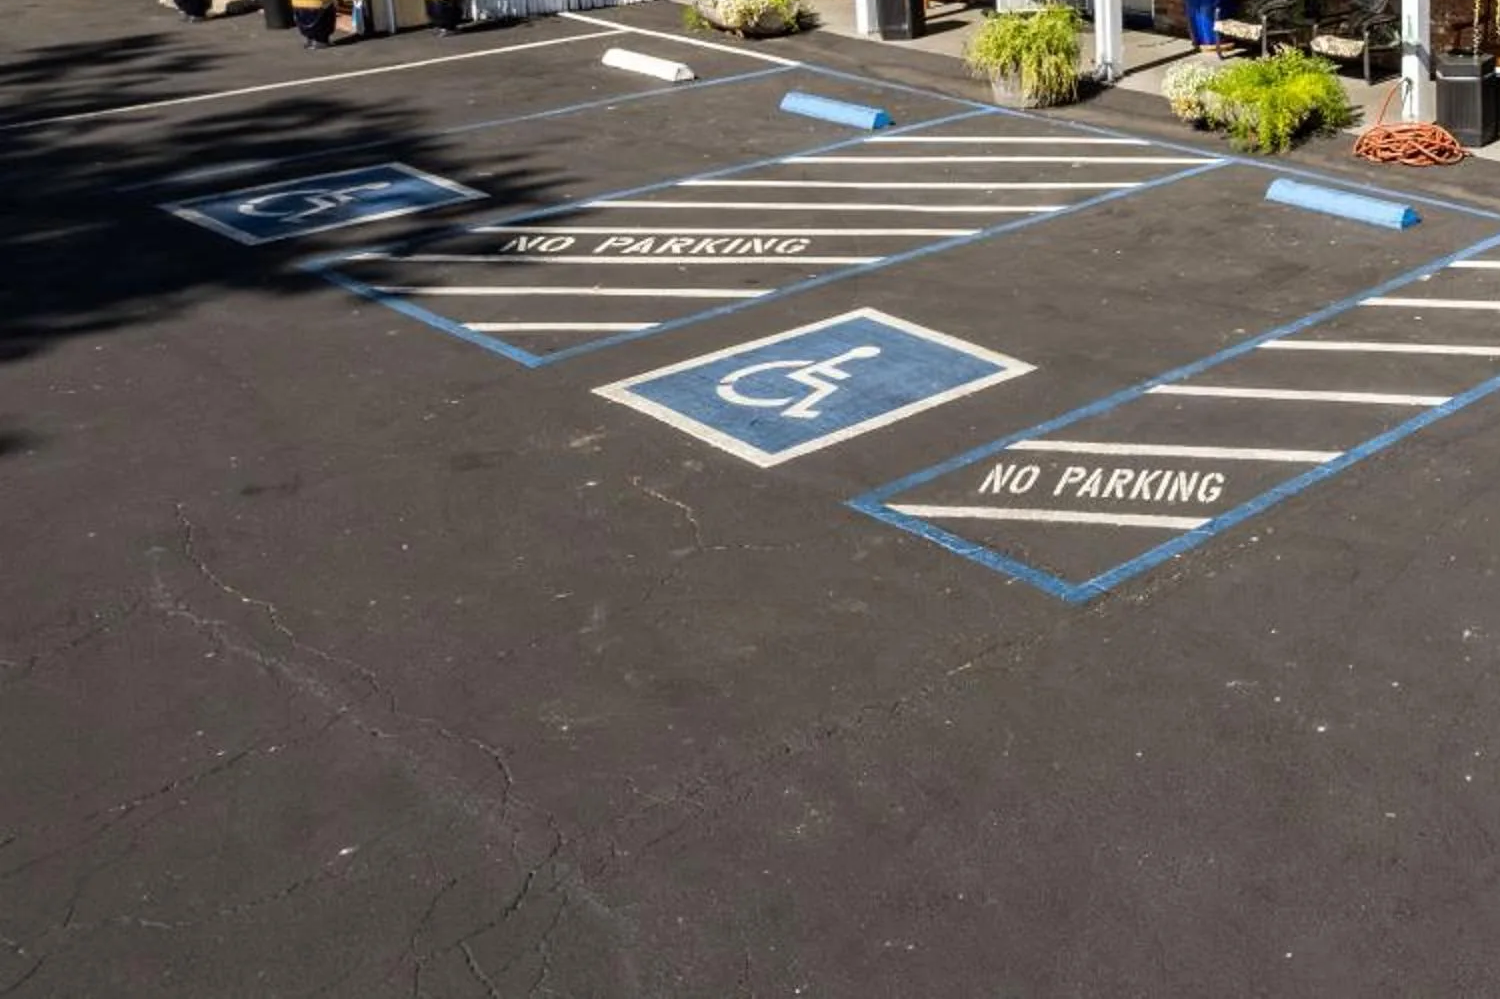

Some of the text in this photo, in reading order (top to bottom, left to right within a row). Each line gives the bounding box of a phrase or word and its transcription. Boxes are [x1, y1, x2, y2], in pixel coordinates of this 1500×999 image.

[501, 236, 811, 254] NO PARKING
[978, 463, 1225, 503] NO PARKING
